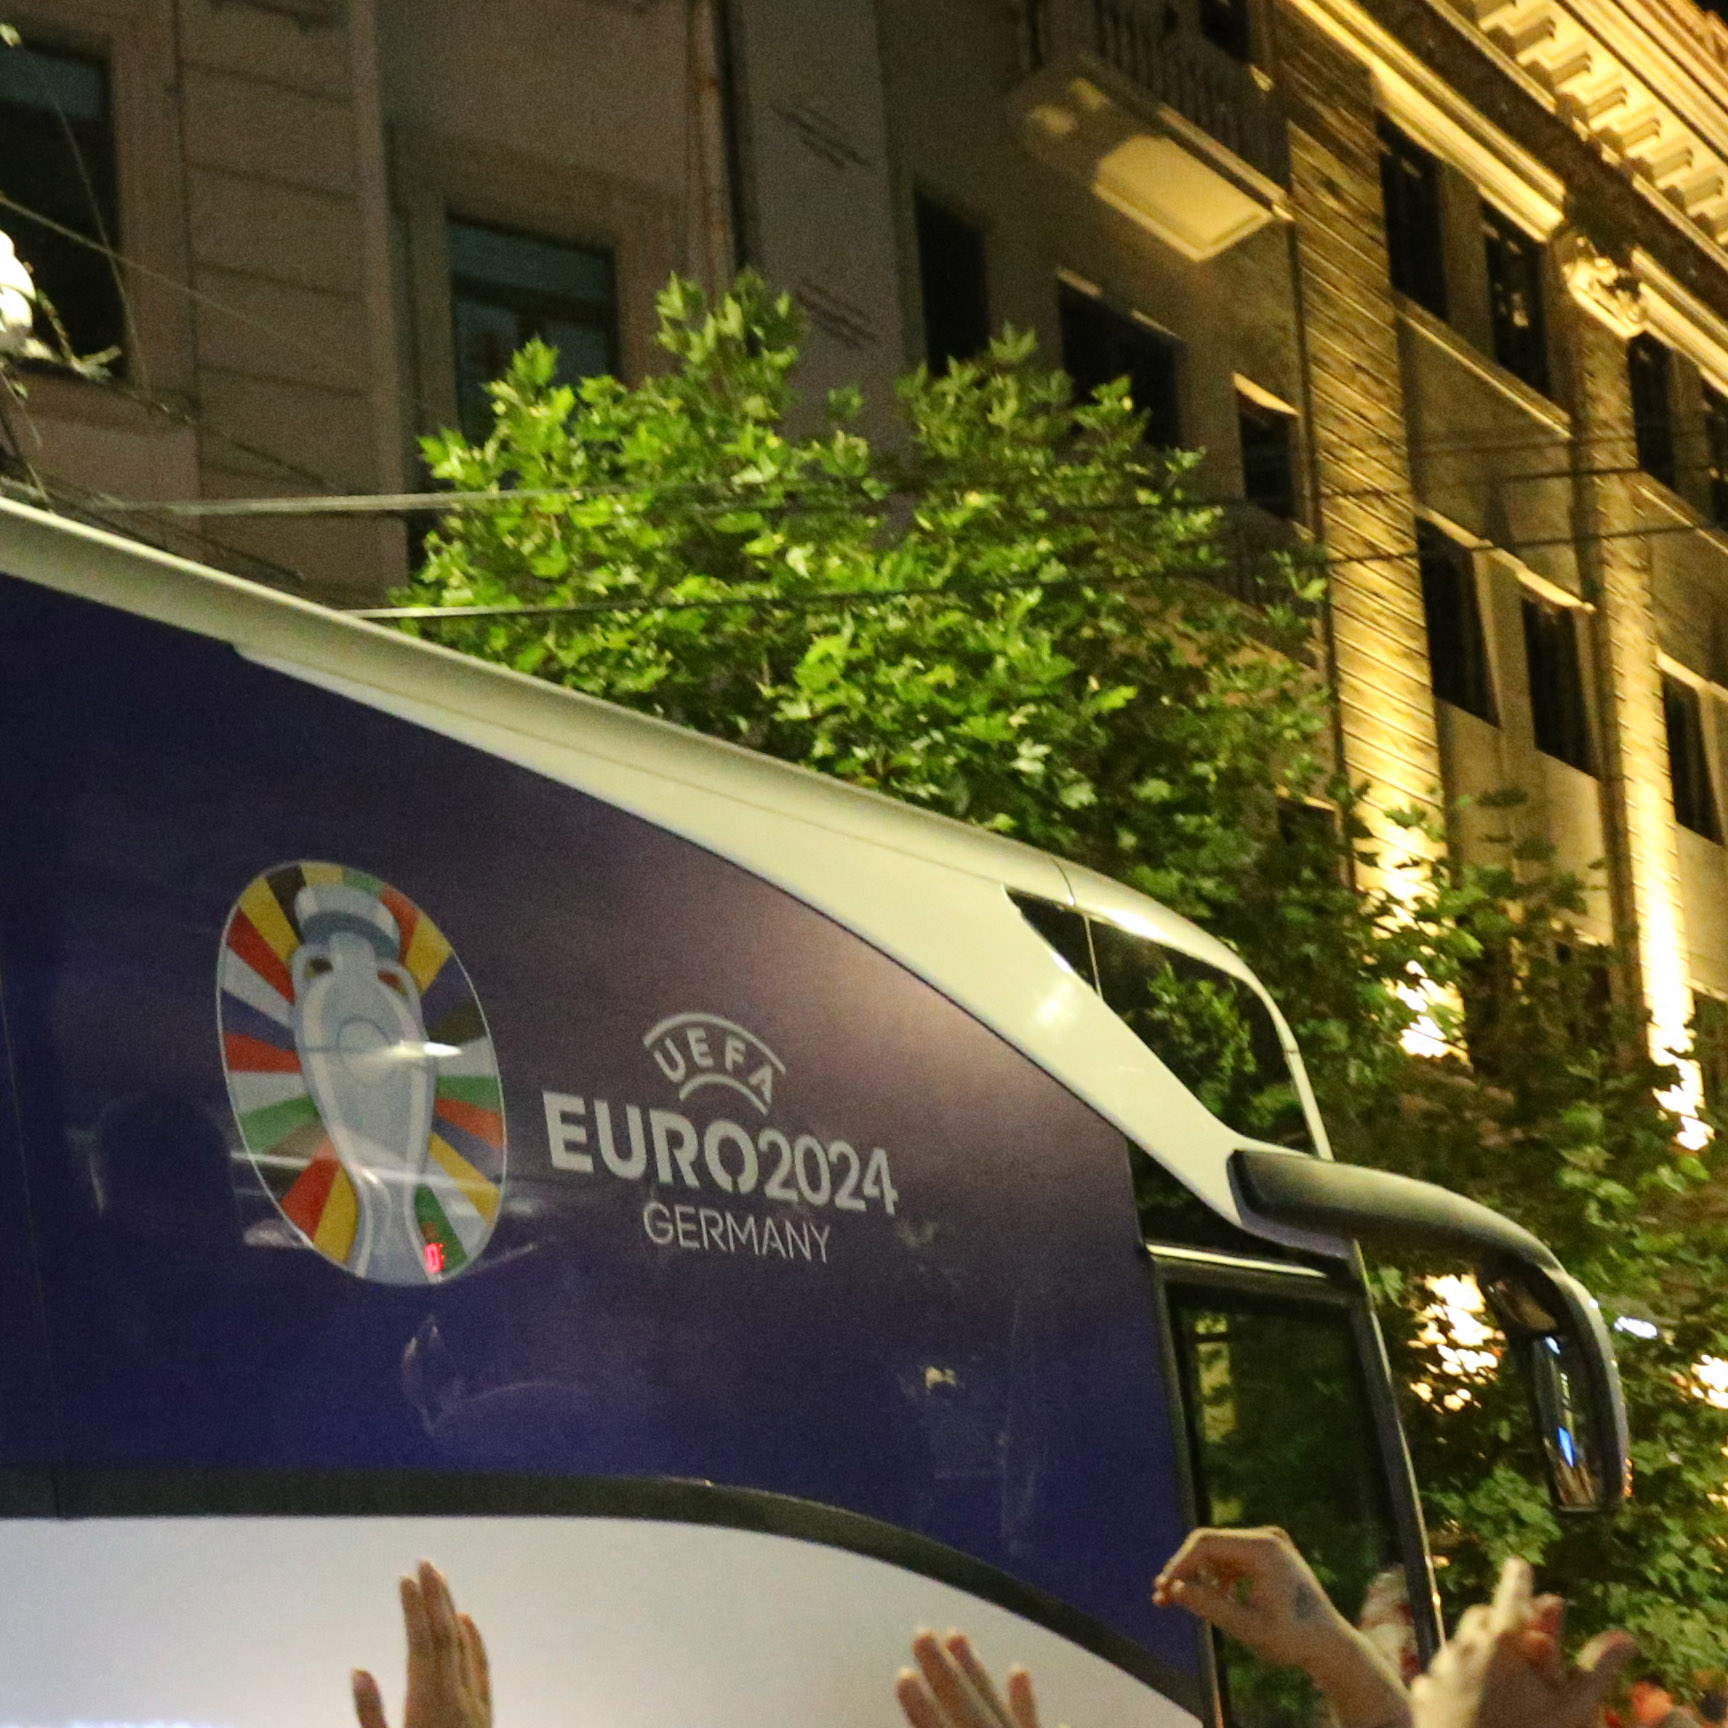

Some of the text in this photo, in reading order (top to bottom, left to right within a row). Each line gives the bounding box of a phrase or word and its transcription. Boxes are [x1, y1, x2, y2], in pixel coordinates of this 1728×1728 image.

[654, 1027, 772, 1103] UEFA
[543, 1091, 899, 1216] EURO2024
[643, 1200, 830, 1264] GERMANY
